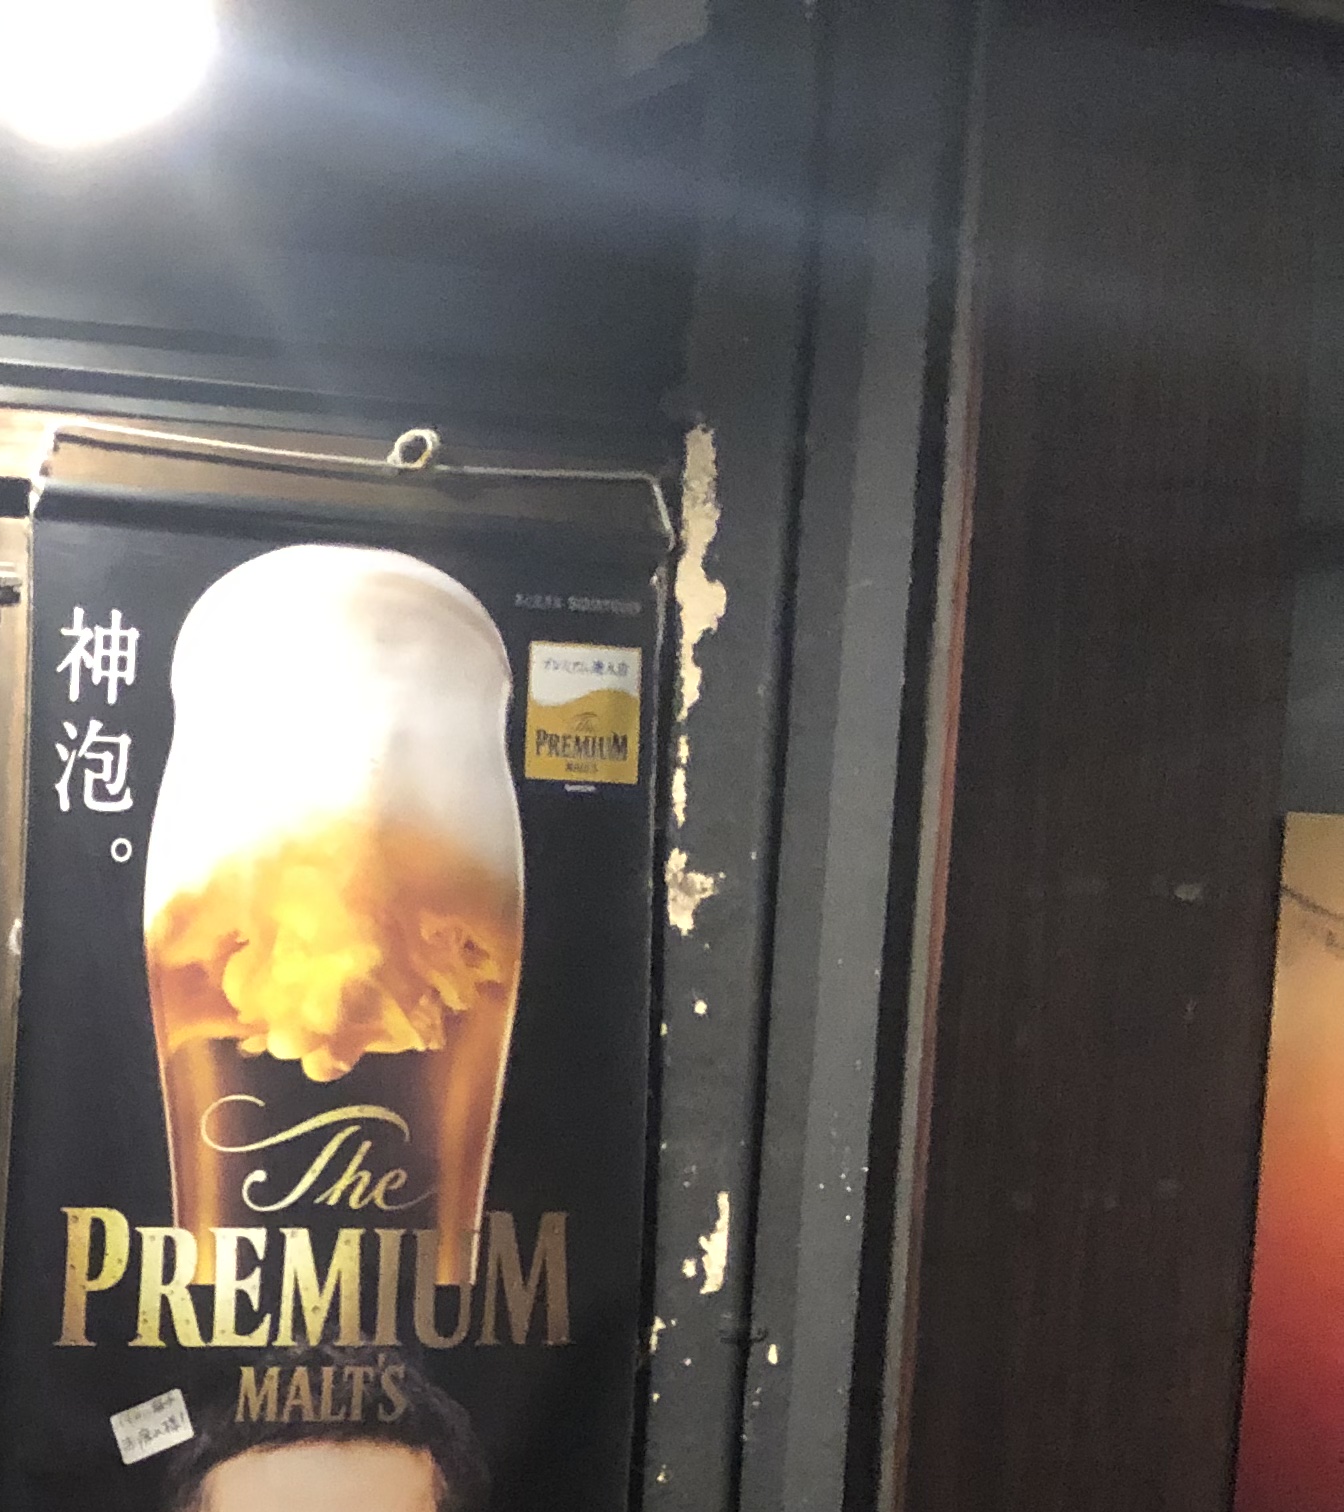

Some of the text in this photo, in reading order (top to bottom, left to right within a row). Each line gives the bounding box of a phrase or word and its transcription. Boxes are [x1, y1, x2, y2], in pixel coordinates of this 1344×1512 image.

[54, 605, 141, 863] 神泡。
[535, 729, 628, 761] PREMIUM
[201, 1095, 436, 1214] The
[53, 1205, 576, 1348] PREMIUM
[234, 1352, 411, 1424] MALT'S
